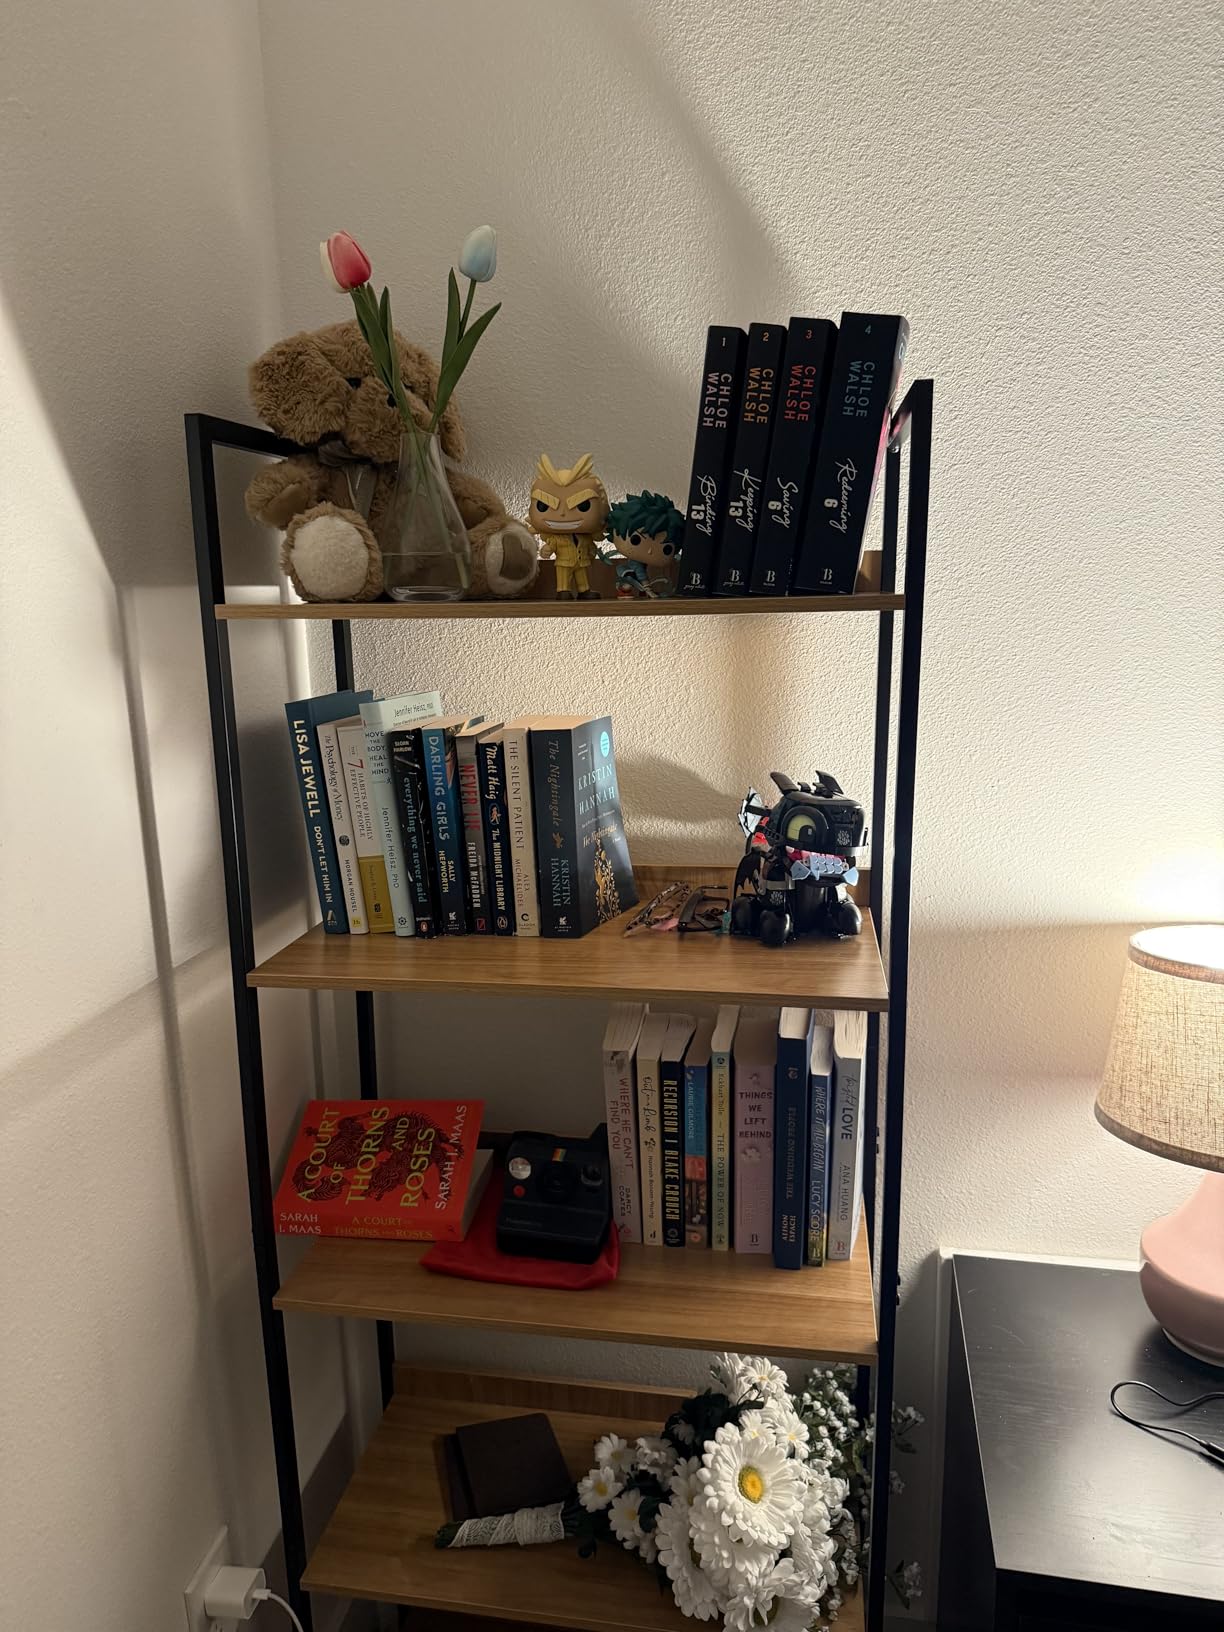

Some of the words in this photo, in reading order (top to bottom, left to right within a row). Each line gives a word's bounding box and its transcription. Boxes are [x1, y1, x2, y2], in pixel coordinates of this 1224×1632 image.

[722, 337, 726, 347] 1
[763, 332, 770, 342] 2
[806, 329, 813, 339] 3
[865, 325, 872, 335] 4
[703, 372, 720, 427] WALSH
[715, 373, 732, 429] CHLOE
[744, 367, 761, 422] WALSH
[757, 368, 774, 424] CHLOE
[784, 365, 803, 420] WALSH
[797, 366, 816, 421] CHLOE
[842, 360, 862, 416] WALSH
[856, 361, 875, 417] CHLOE
[696, 474, 717, 537] Binding
[729, 501, 744, 517] 13
[734, 468, 762, 533] Keeping
[768, 500, 782, 511] 6
[771, 477, 799, 529] Saving
[824, 498, 838, 508] 6
[829, 458, 858, 534] Redeeming
[690, 503, 706, 521] 13
[293, 720, 310, 755] LISA
[509, 741, 519, 760] THE
[548, 740, 560, 760] The
[347, 759, 364, 769] 7
[371, 768, 389, 776] MIND
[428, 736, 446, 796] DARLING
[485, 745, 498, 774] Matt
[300, 758, 321, 818] JEWELL
[324, 745, 339, 788] Psychology
[333, 792, 344, 822] Money
[350, 769, 362, 809] EFFECTIVE
[357, 772, 367, 800] HABITS
[459, 764, 478, 805] NEVER
[485, 776, 500, 800] Haig
[510, 765, 522, 801] SILENT
[578, 763, 613, 791] KRISTIN
[403, 777, 417, 833] everything
[547, 764, 562, 826] Nightingale
[579, 786, 615, 815] HANNAH
[354, 810, 365, 838] PEOPLE
[382, 807, 391, 845] Jennifer
[436, 801, 450, 840] GIRLS
[491, 828, 500, 840] The
[514, 807, 525, 849] PATIENT
[314, 826, 326, 854] DON'T
[411, 835, 419, 849] we
[319, 856, 328, 873] LET
[412, 851, 422, 881] never
[467, 842, 477, 868] FREIDA
[493, 842, 503, 878] MIDNIGHT
[322, 874, 331, 891] HIM
[345, 859, 353, 886] MORGAN
[349, 888, 358, 912] HOUSEL
[438, 850, 449, 893] HEPWORTH
[447, 860, 456, 882] SALLY
[551, 858, 561, 907] HANNAH
[561, 859, 571, 905] KRISTIN
[325, 893, 333, 903] IN
[416, 883, 428, 903] said
[495, 880, 506, 911] LIBRARY
[619, 1077, 632, 1115] WHERE
[641, 1076, 656, 1095] Out
[687, 1082, 695, 1106] LAURIE
[609, 1100, 620, 1124] FIND
[663, 1080, 679, 1133] RECURSION
[815, 1086, 826, 1115] WHERE
[621, 1120, 632, 1134] HE
[643, 1106, 657, 1132] Limb
[687, 1108, 695, 1139] GILMORE
[743, 1117, 767, 1125] LEFT
[815, 1117, 825, 1127] IT
[841, 1107, 854, 1140] LOVE
[304, 1107, 340, 1180] COURT
[391, 1117, 410, 1151] AND
[611, 1130, 621, 1150] YOU
[717, 1133, 725, 1152] THE
[739, 1131, 772, 1139] BEHIND
[814, 1128, 825, 1141] ALL
[345, 1106, 390, 1205] THORNS
[400, 1127, 436, 1207] ROSES
[435, 1160, 455, 1210] SARAH
[449, 1105, 467, 1144] MAAS
[665, 1150, 680, 1179] BLAKE
[813, 1143, 825, 1172] BEGAN
[330, 1161, 345, 1184] OF
[717, 1157, 725, 1188] POWER
[841, 1165, 851, 1185] ANA
[297, 1188, 315, 1202] A
[665, 1184, 680, 1220] CROUCH
[717, 1190, 725, 1203] OF
[810, 1180, 821, 1208] LUCY
[840, 1187, 849, 1221] HUANG
[280, 1212, 318, 1223] SARAH
[288, 1225, 321, 1234] MAAS
[352, 1216, 360, 1225] A
[363, 1216, 401, 1226] COURT
[717, 1204, 725, 1226] NOW
[810, 1209, 820, 1241] SCORE
[397, 1229, 433, 1240] ROSES
